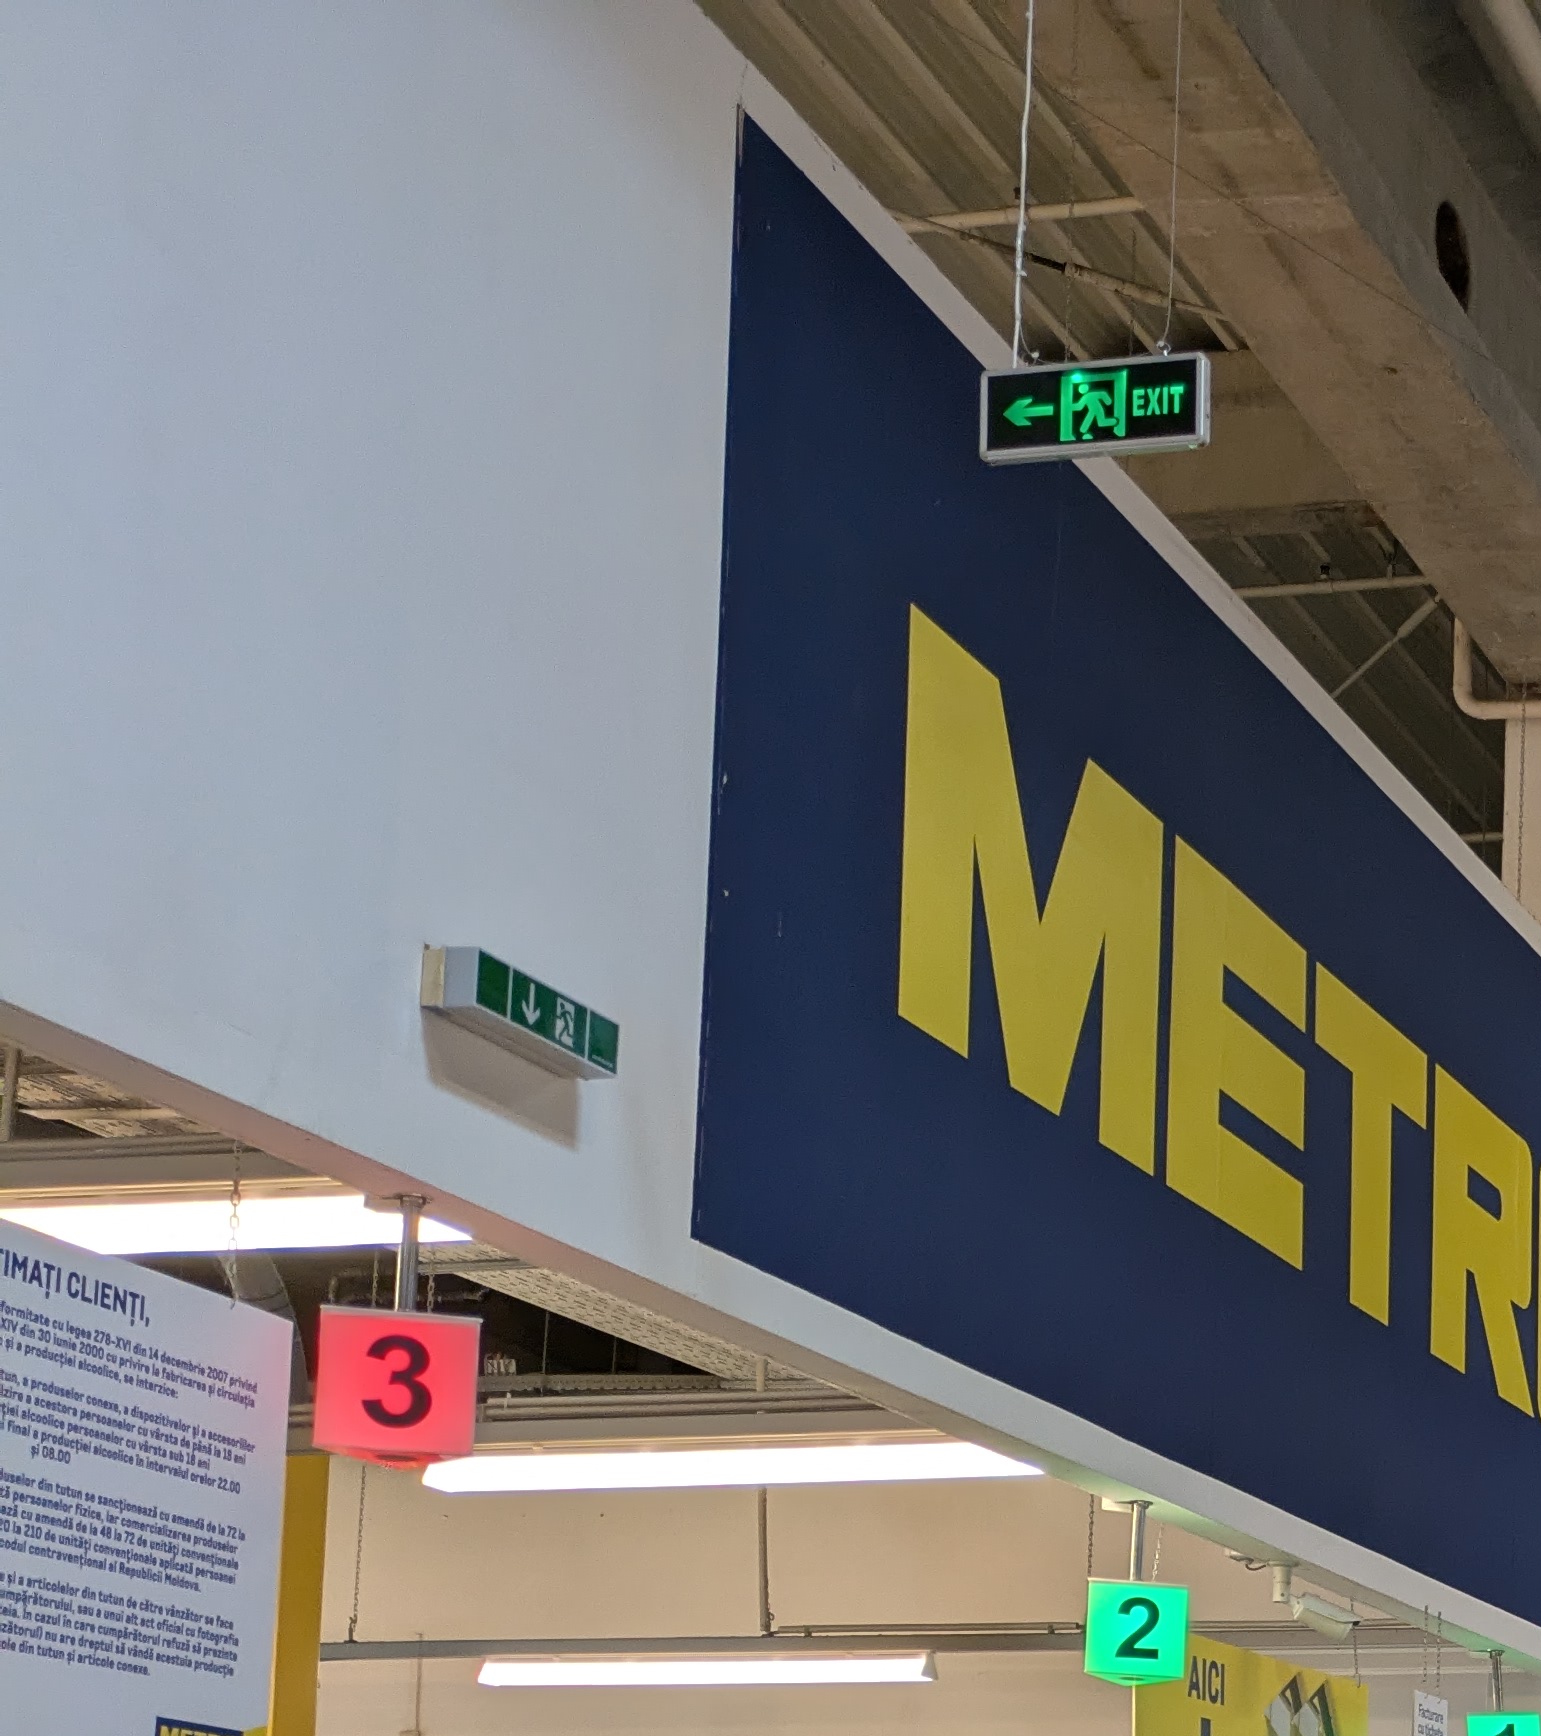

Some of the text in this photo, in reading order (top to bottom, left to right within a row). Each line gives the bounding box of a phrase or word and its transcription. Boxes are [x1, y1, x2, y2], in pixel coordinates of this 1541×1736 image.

[1132, 385, 1184, 417] EXIT
[67, 1271, 149, 1328] CLIENȚI,
[361, 1335, 432, 1428] 3
[1115, 1597, 1159, 1660] 2
[1187, 1655, 1225, 1706] AICI
[1417, 1703, 1444, 1725] Facturare
